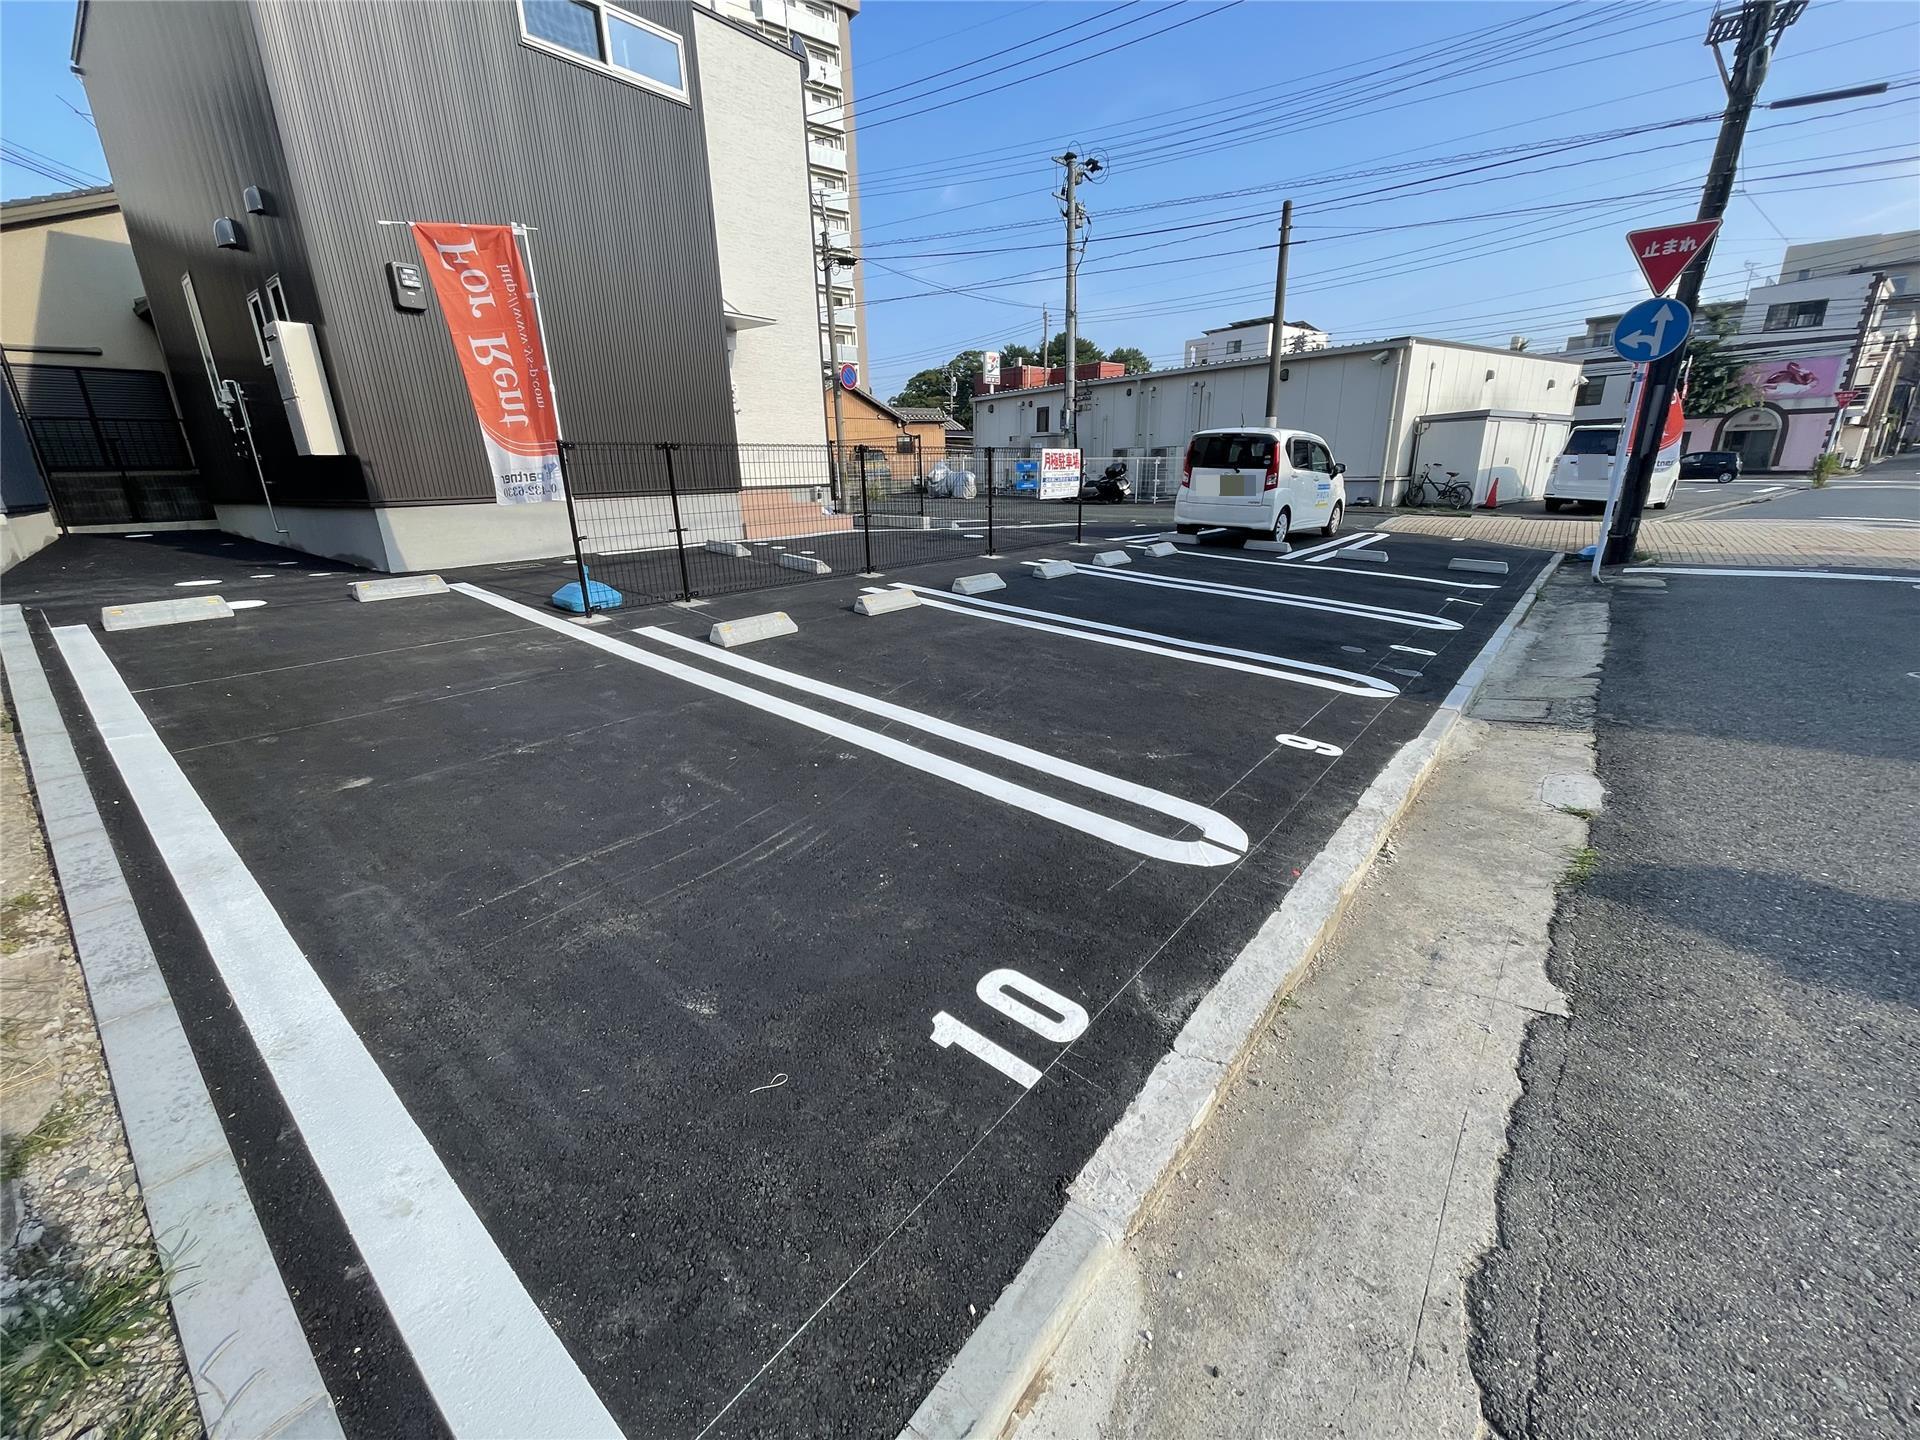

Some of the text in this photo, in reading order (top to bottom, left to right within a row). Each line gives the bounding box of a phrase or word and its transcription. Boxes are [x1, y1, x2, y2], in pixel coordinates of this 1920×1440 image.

[1641, 236, 1698, 258] 止まれ
[1043, 452, 1079, 470] 月極駐車場
[1389, 644, 1437, 656] 8
[1275, 733, 1343, 756] 9
[930, 968, 1089, 1090] 10
